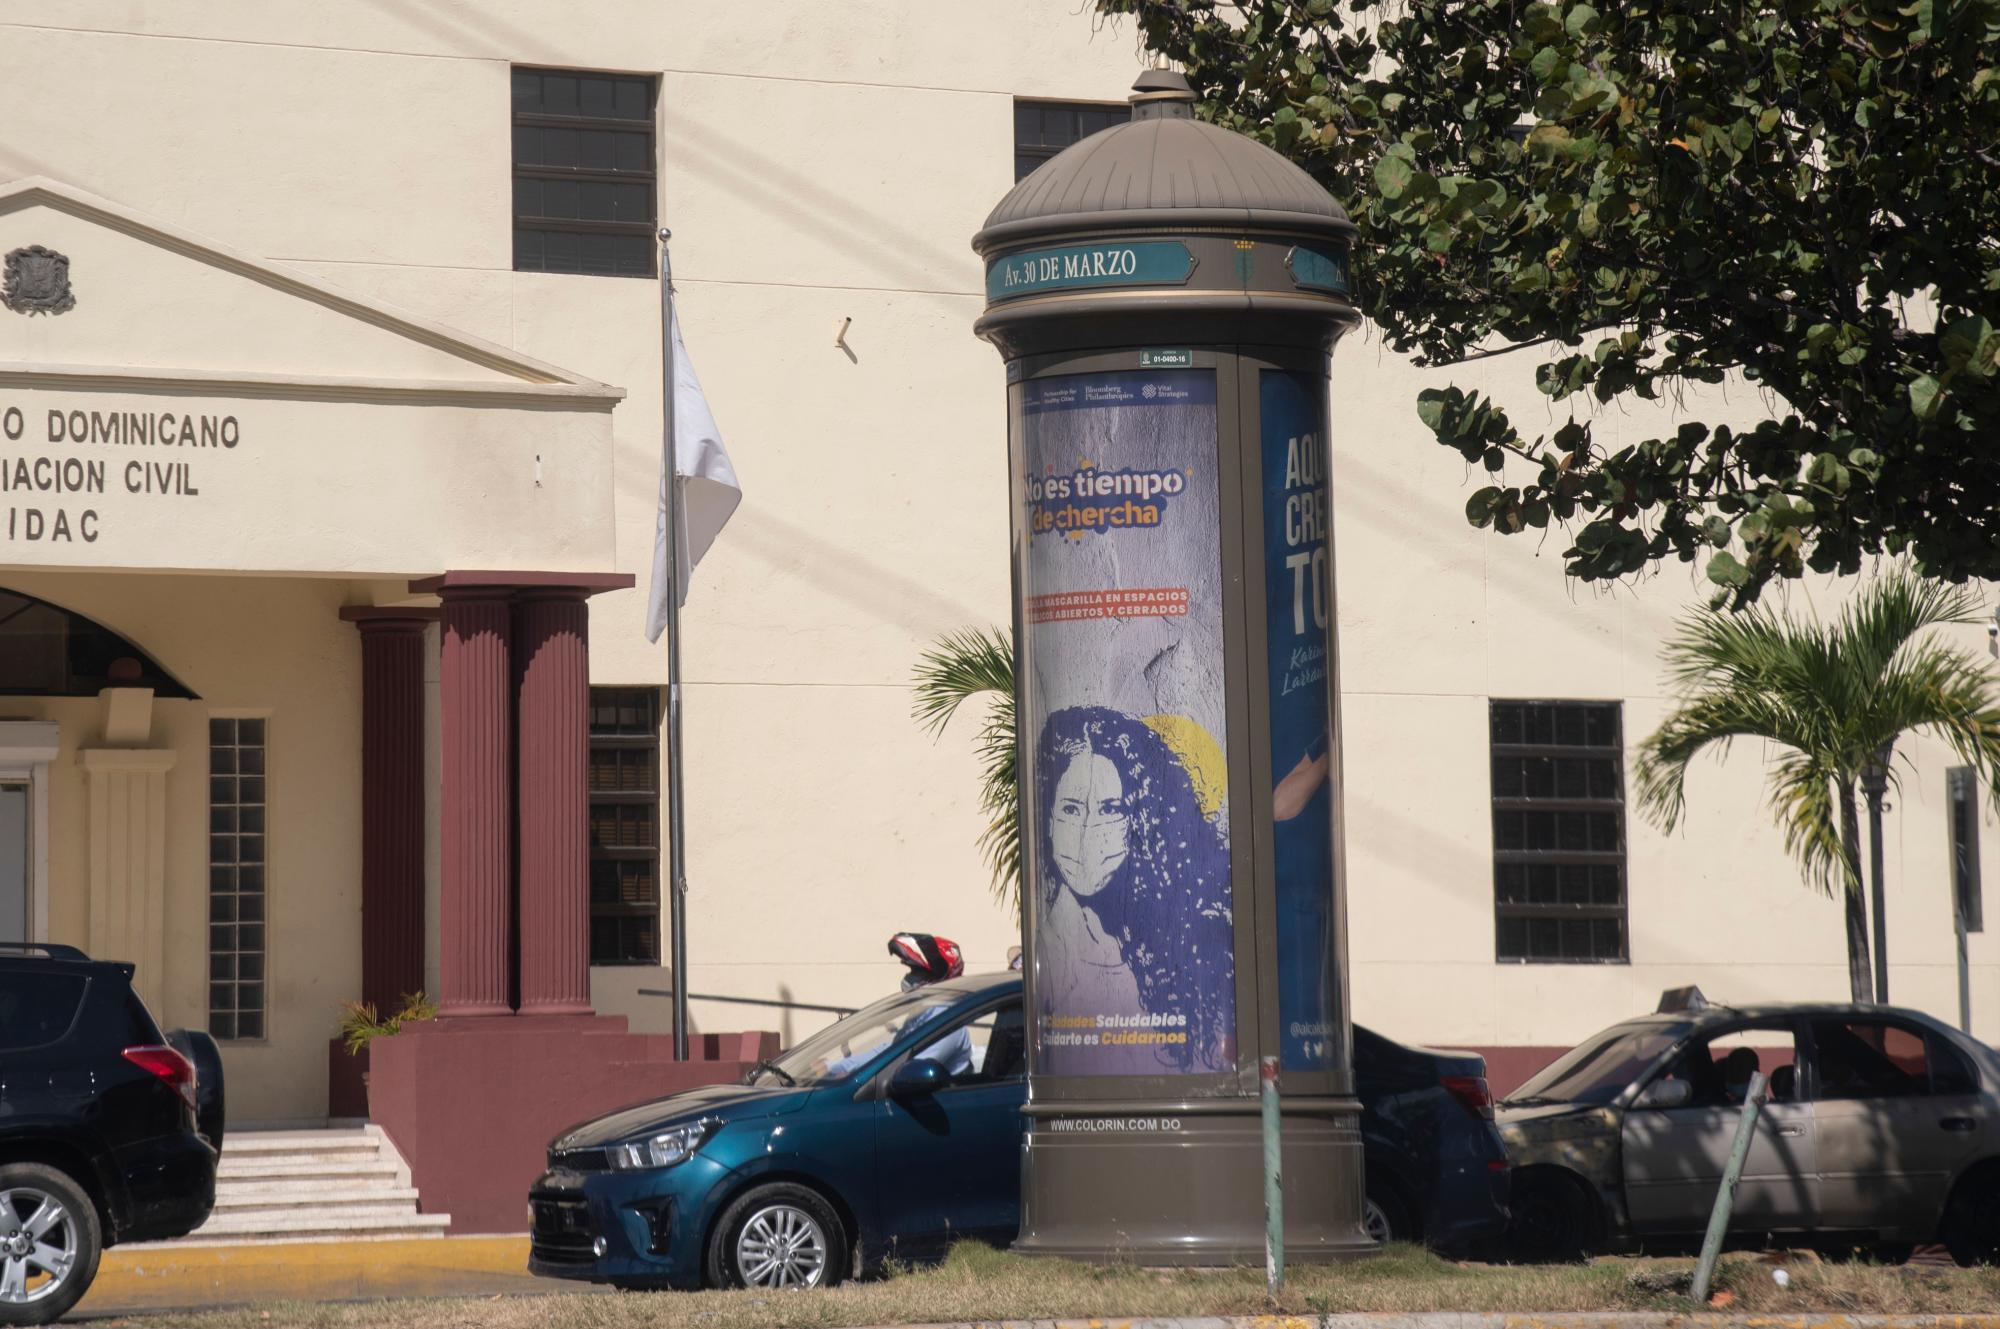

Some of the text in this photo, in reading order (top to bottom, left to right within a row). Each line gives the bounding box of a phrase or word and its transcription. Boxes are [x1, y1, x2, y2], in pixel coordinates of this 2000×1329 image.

[1005, 249, 1136, 287] Av. 30 DE MARZO
[48, 409, 239, 448] DOMINICANO
[2, 456, 199, 496] IACION CIVIL
[1045, 479, 1071, 499] es
[1074, 471, 1183, 499] tiempo
[9, 507, 99, 543] IDAC
[1033, 501, 1158, 531] de chercha
[1044, 594, 1102, 606] MASCARILLA
[1106, 593, 1120, 603] EN
[1124, 591, 1188, 602] ESPACIOS
[1055, 608, 1103, 619] ABIERTOS
[1106, 606, 1115, 615] Y
[1117, 605, 1186, 615] CERRADOS
[1043, 1030, 1187, 1046] Cuidarte es Cuidarnos
[1050, 1118, 1181, 1132] WWW.COLORIN.COM DO
